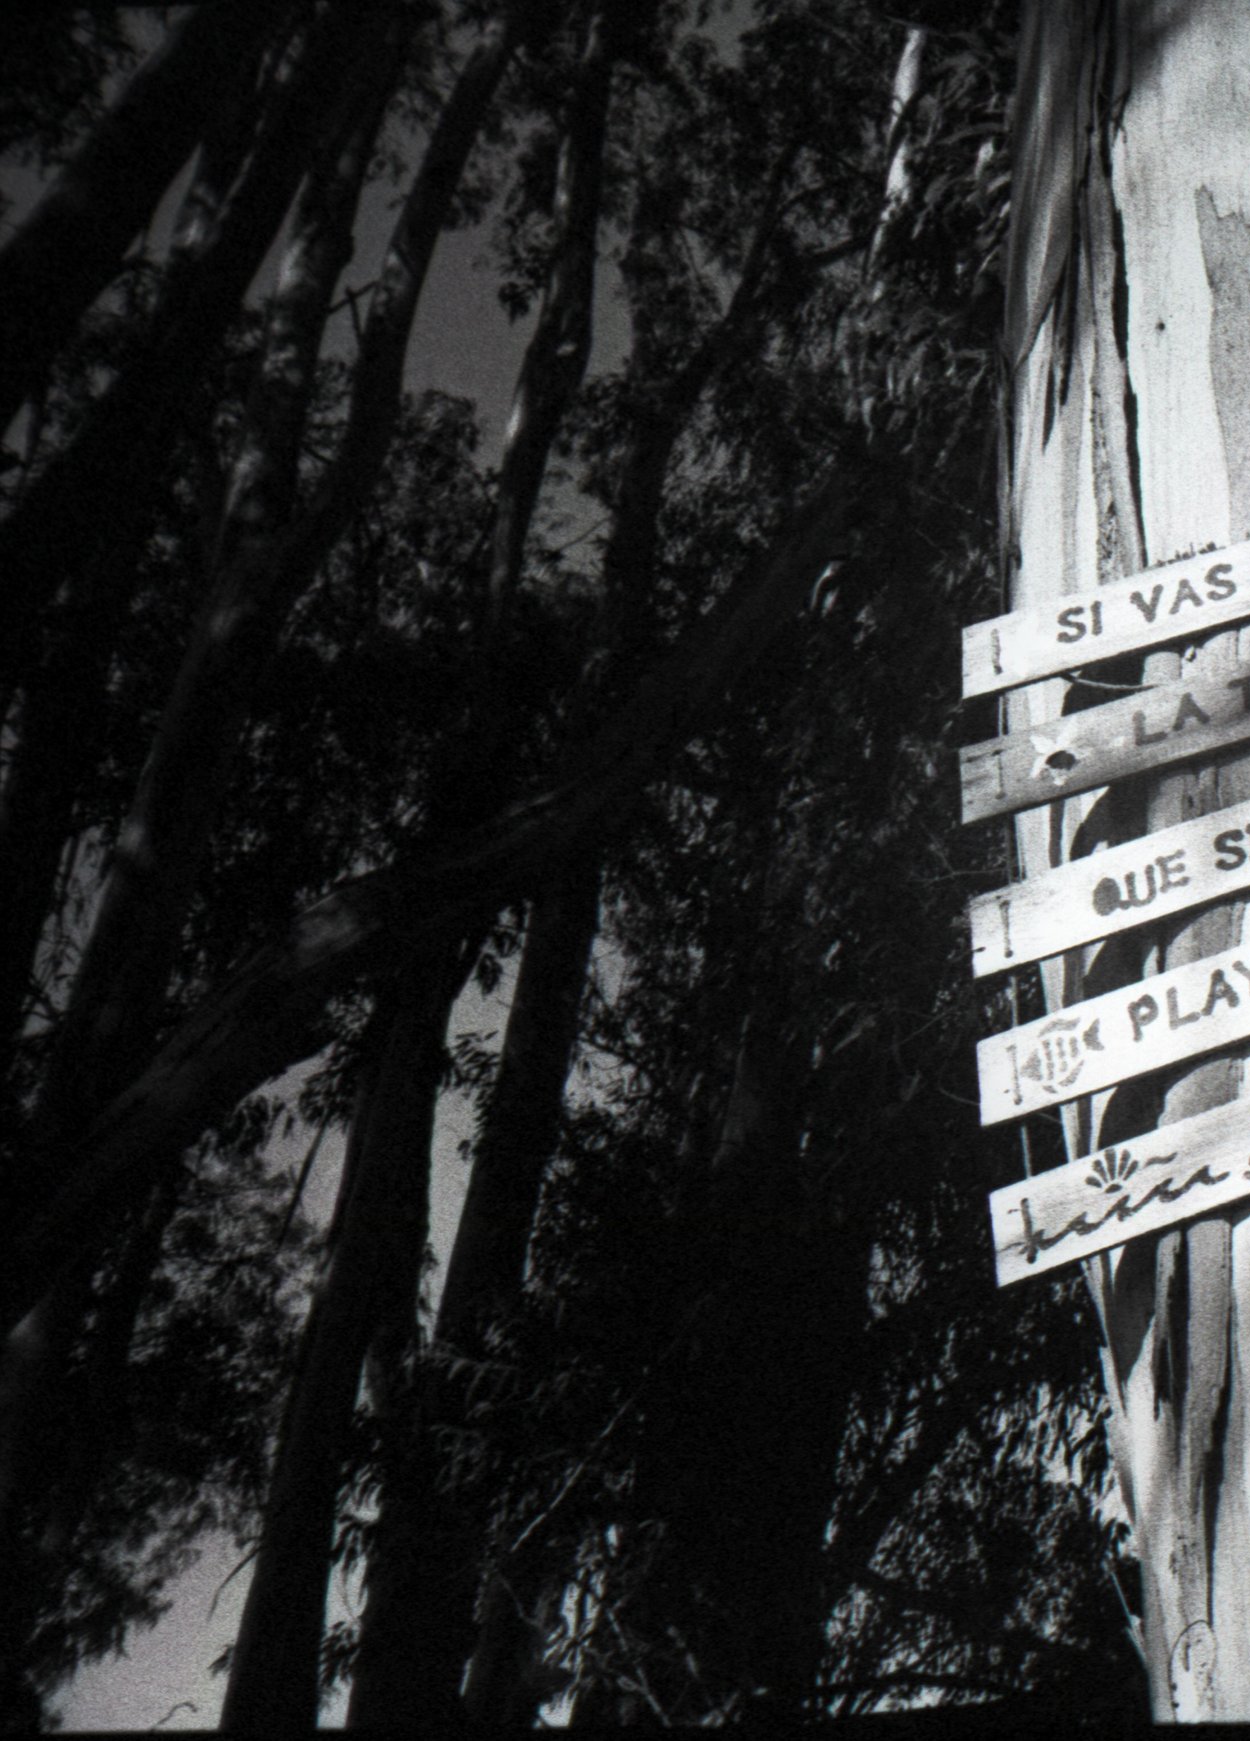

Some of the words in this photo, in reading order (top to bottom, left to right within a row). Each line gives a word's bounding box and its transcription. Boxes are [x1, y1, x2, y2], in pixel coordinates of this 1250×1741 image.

[1057, 601, 1101, 643] SI
[1130, 564, 1237, 623] VAS
[1133, 693, 1210, 746] LA
[1093, 849, 1190, 916] QUE
